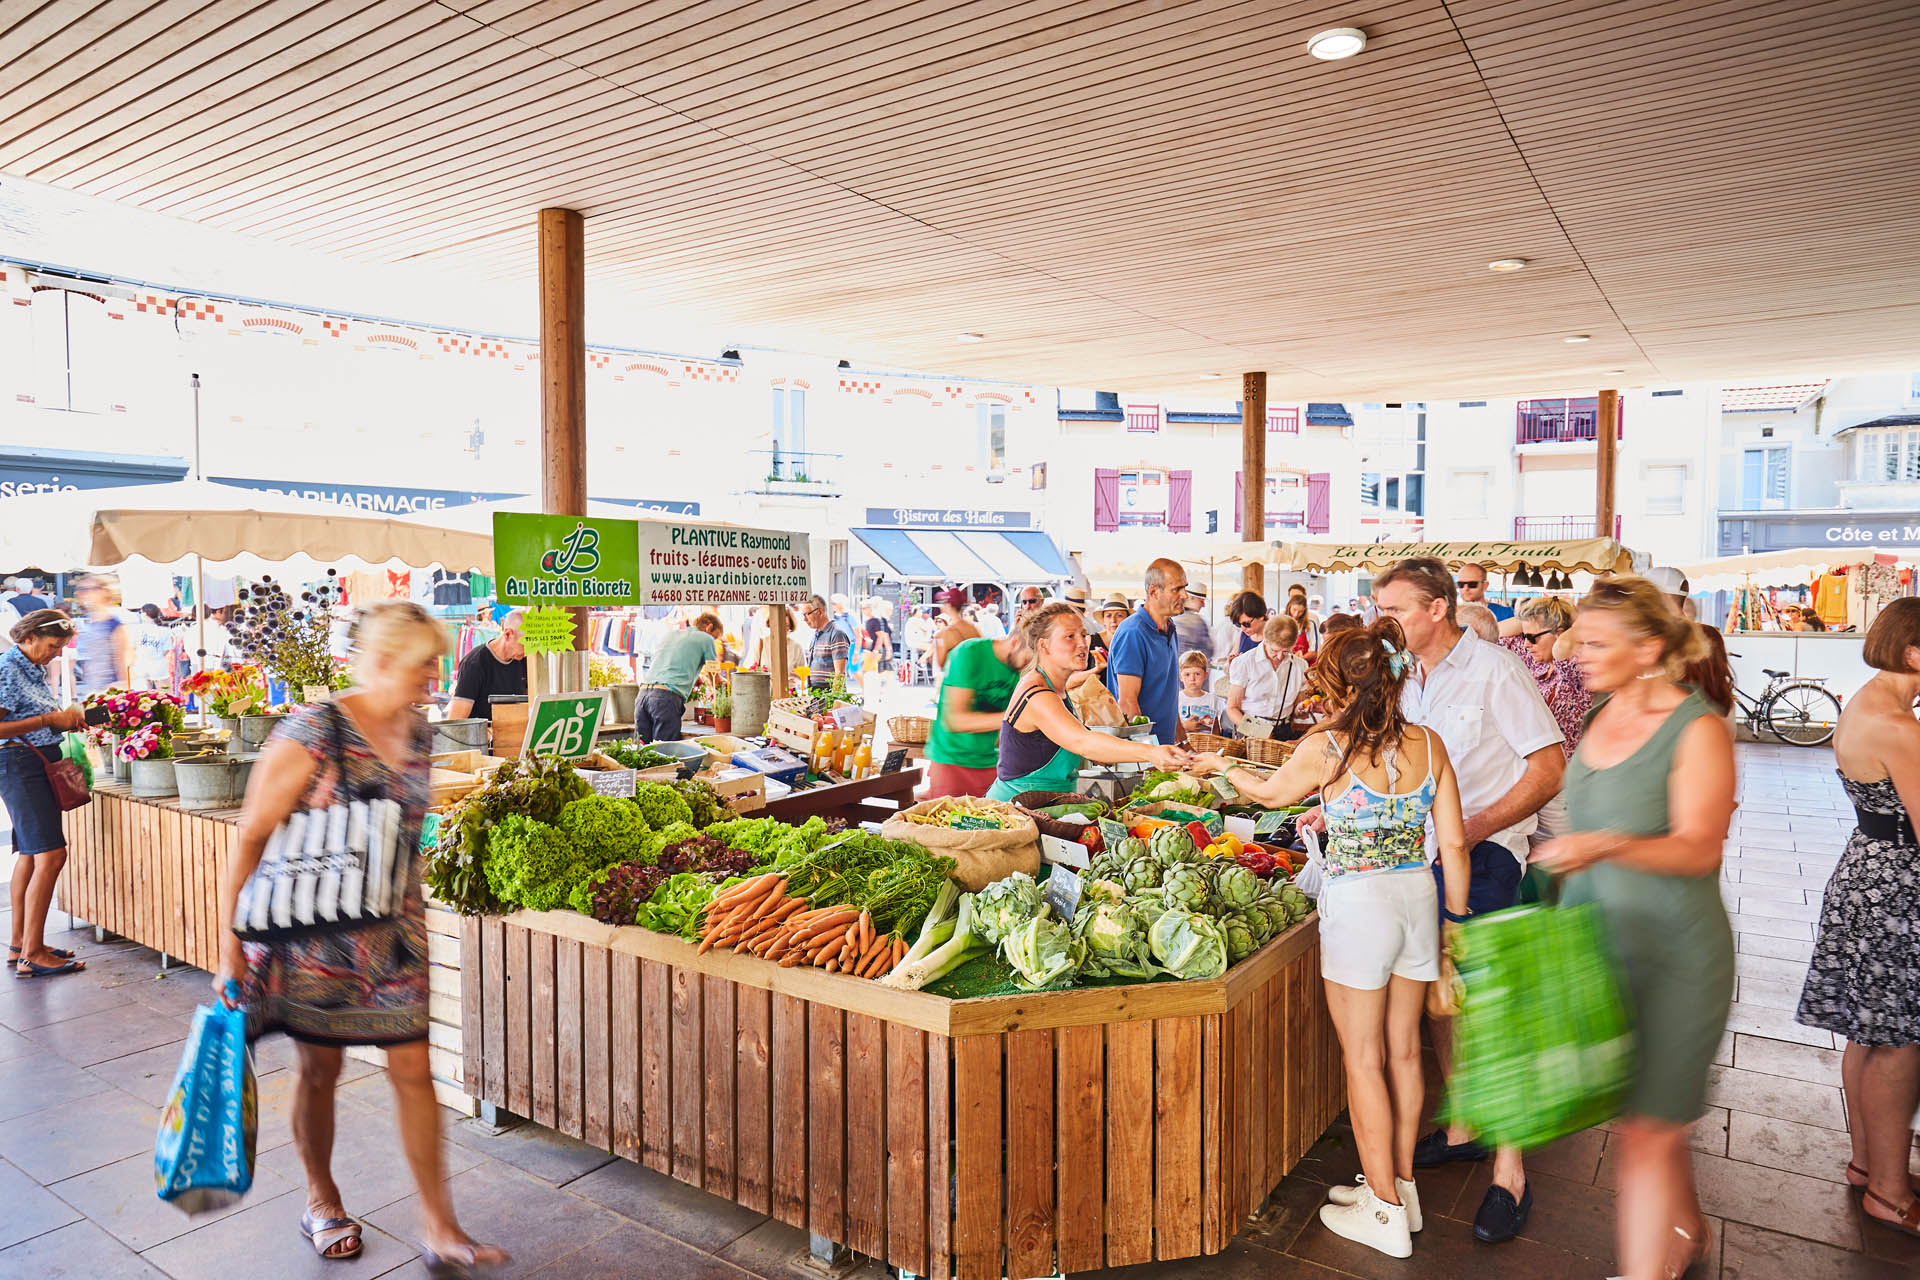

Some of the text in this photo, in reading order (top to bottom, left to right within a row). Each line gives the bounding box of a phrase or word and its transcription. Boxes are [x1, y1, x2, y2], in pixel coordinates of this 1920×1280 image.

[893, 509, 1005, 525] Bistrot des Halles
[741, 532, 791, 551] Raymond
[1825, 526, 1873, 542] Côte
[1878, 528, 1898, 542] et
[1329, 543, 1562, 558] La Corbeille de Fruits
[650, 549, 689, 566] fruits
[698, 551, 750, 569] légumes
[757, 555, 788, 570] oeufs
[791, 555, 806, 571] bio
[506, 576, 632, 597] Au Jardin Bioretz
[651, 571, 807, 587] www.aujardinbioretz.com
[651, 589, 683, 602] 44680
[685, 589, 705, 602] STE
[707, 589, 751, 602] PAZANNE
[758, 590, 769, 602] 02
[769, 590, 779, 602] 51
[781, 590, 789, 602] 11
[534, 717, 584, 756] AB
